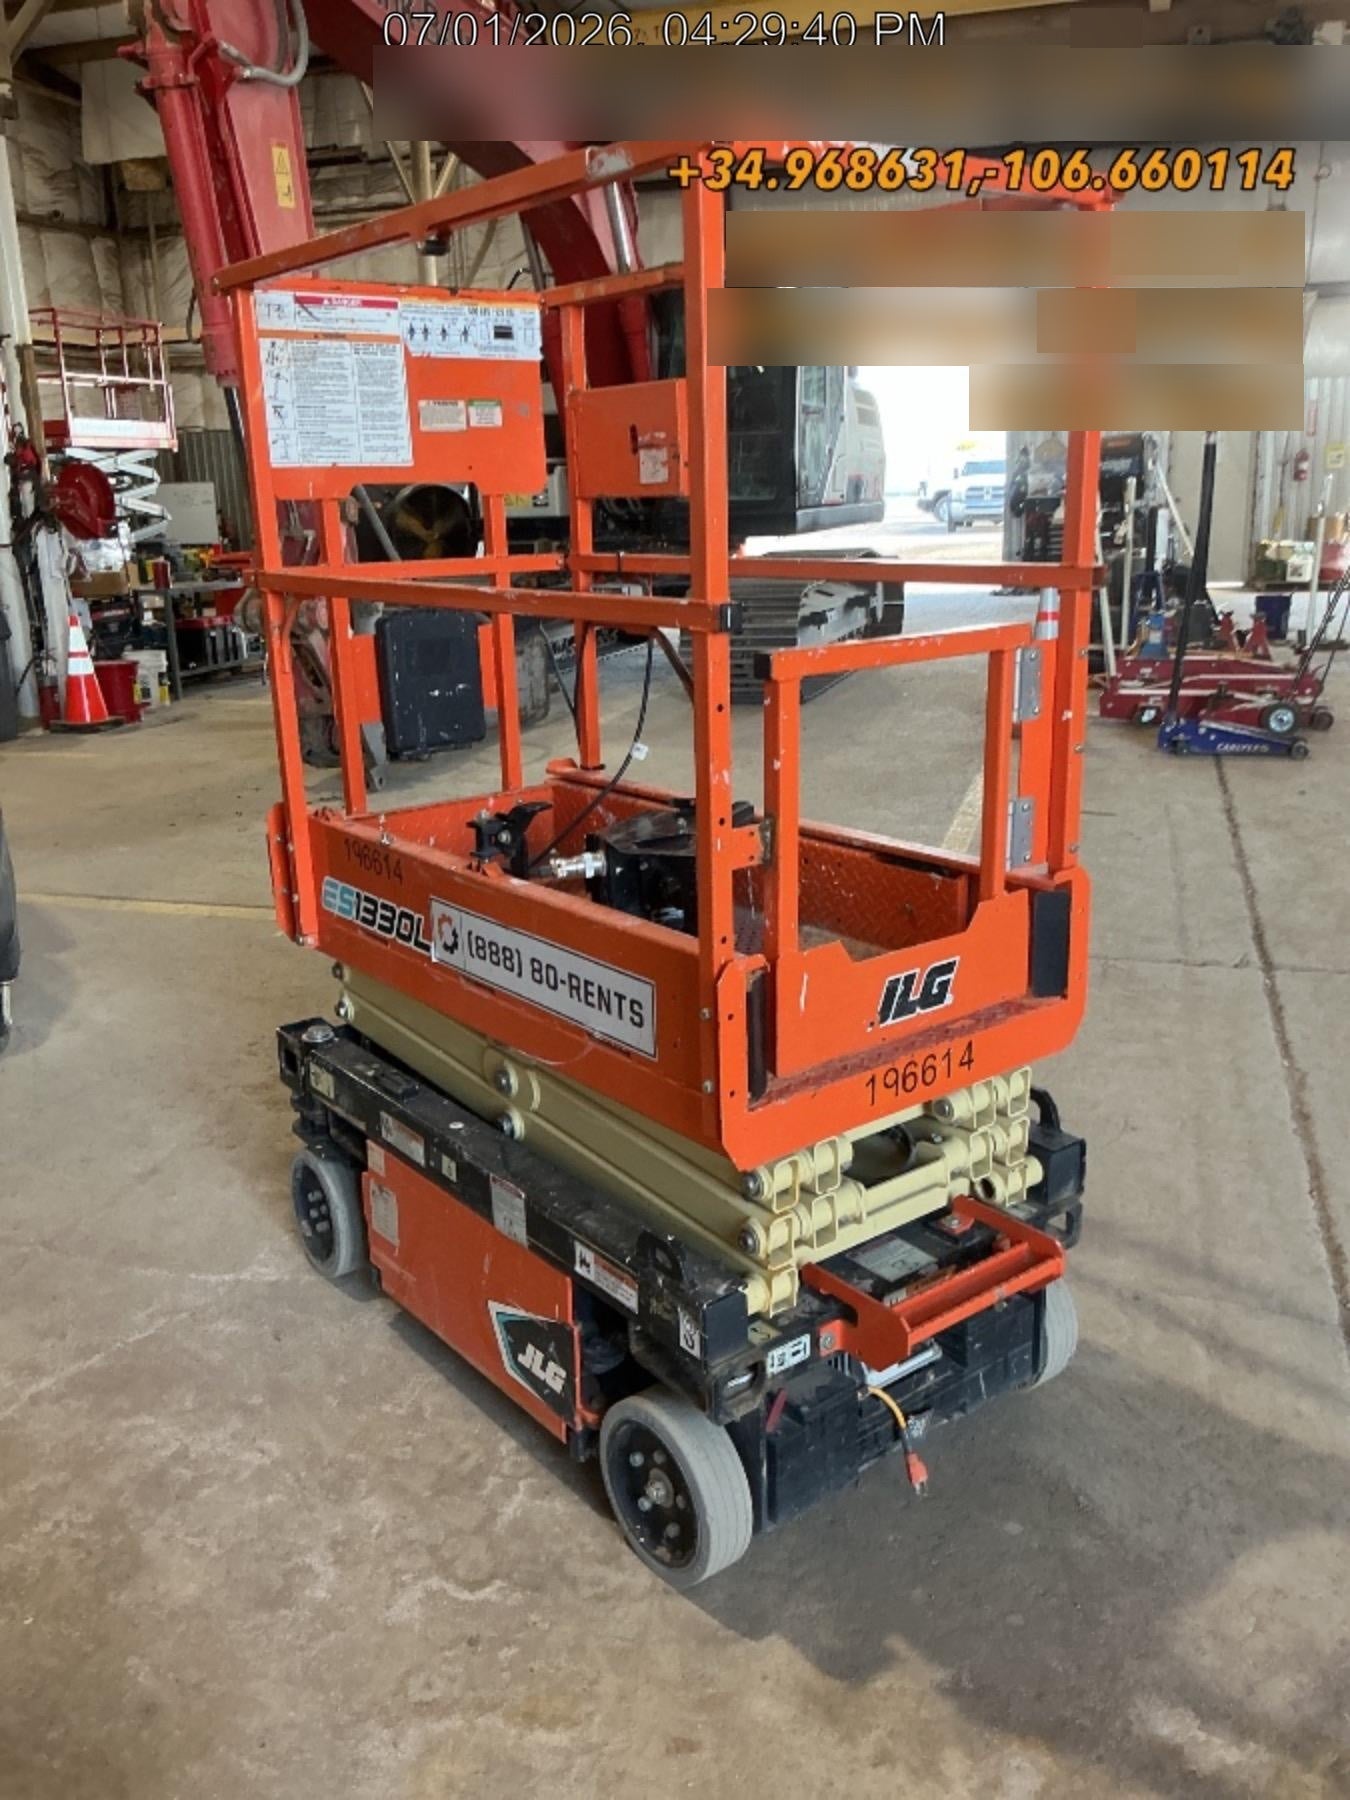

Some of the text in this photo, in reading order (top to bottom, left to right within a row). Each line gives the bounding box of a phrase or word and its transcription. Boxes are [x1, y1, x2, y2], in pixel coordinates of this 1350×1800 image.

[344, 837, 404, 884] 196614
[323, 877, 432, 955] ES1330L
[466, 930, 646, 1030] (888) 80-RENTS
[864, 1040, 976, 1106] 196614
[517, 1342, 567, 1395] JLG
